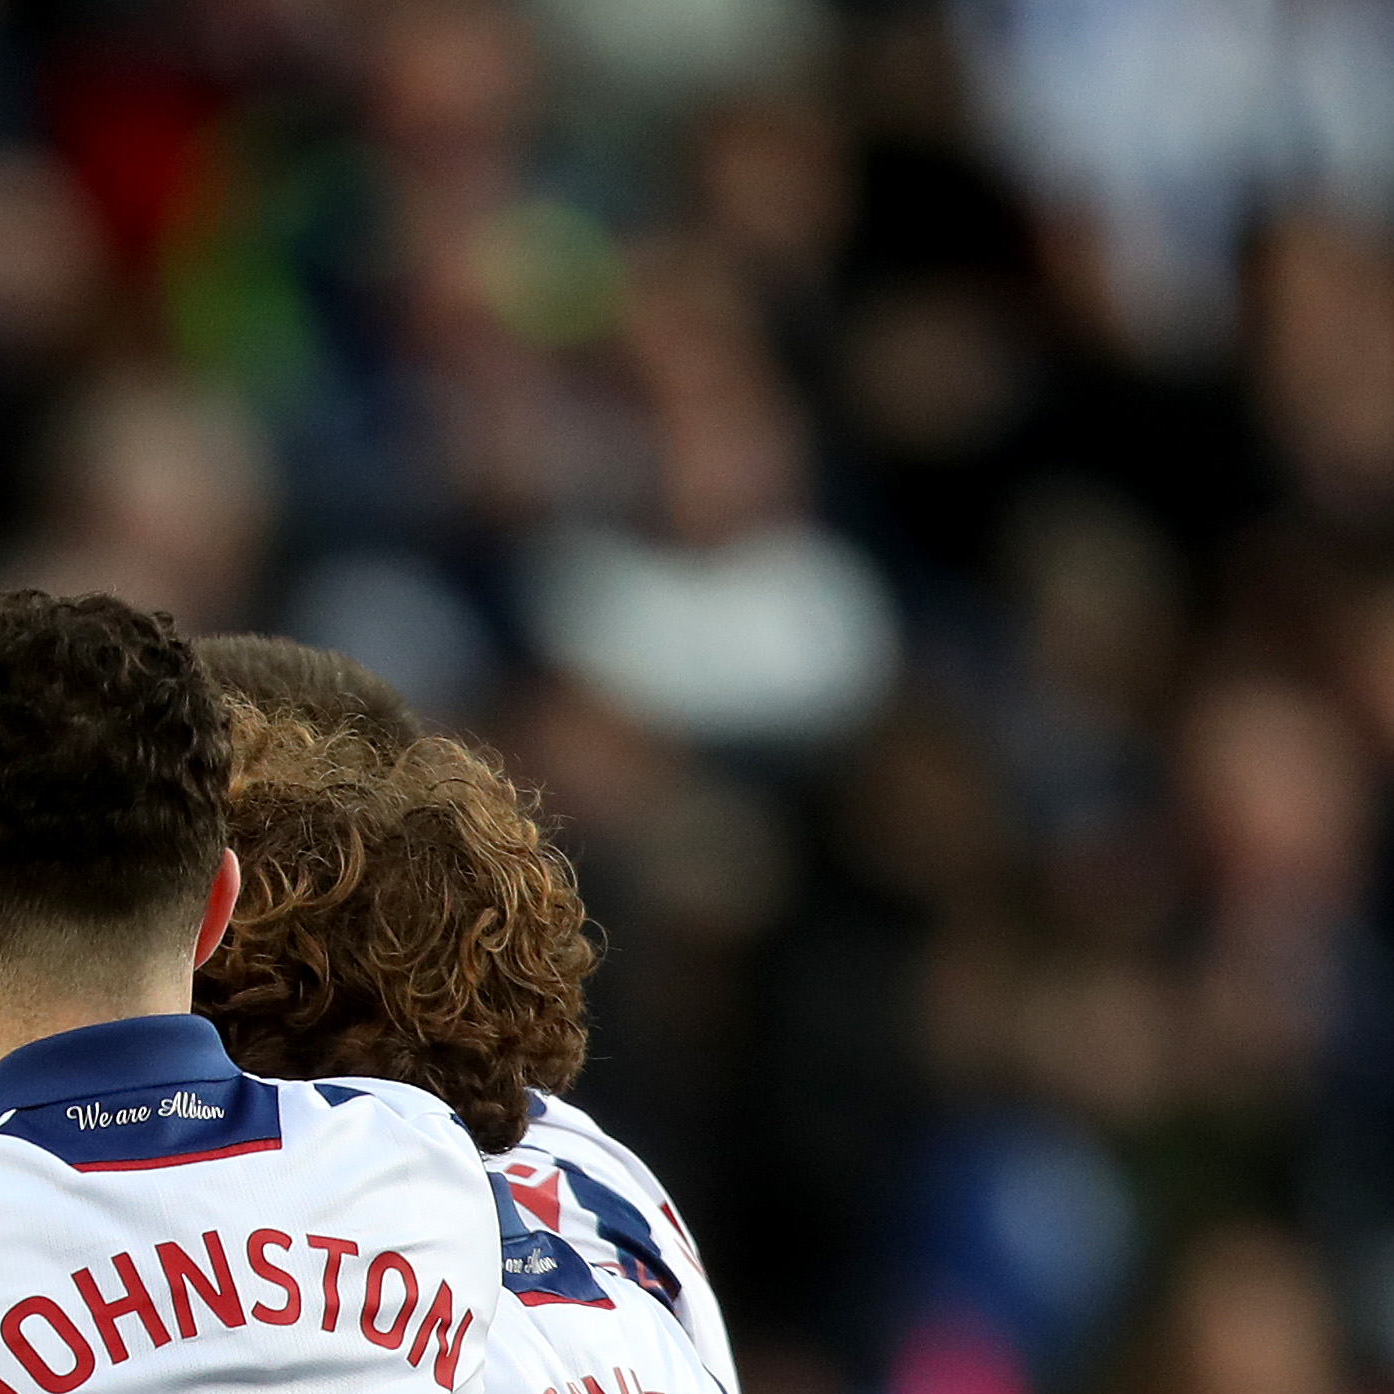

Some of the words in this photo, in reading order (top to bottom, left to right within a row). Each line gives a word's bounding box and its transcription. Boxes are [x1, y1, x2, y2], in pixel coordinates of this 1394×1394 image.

[66, 1102, 113, 1130] We
[115, 1105, 151, 1125] are
[158, 1091, 225, 1119] Albion
